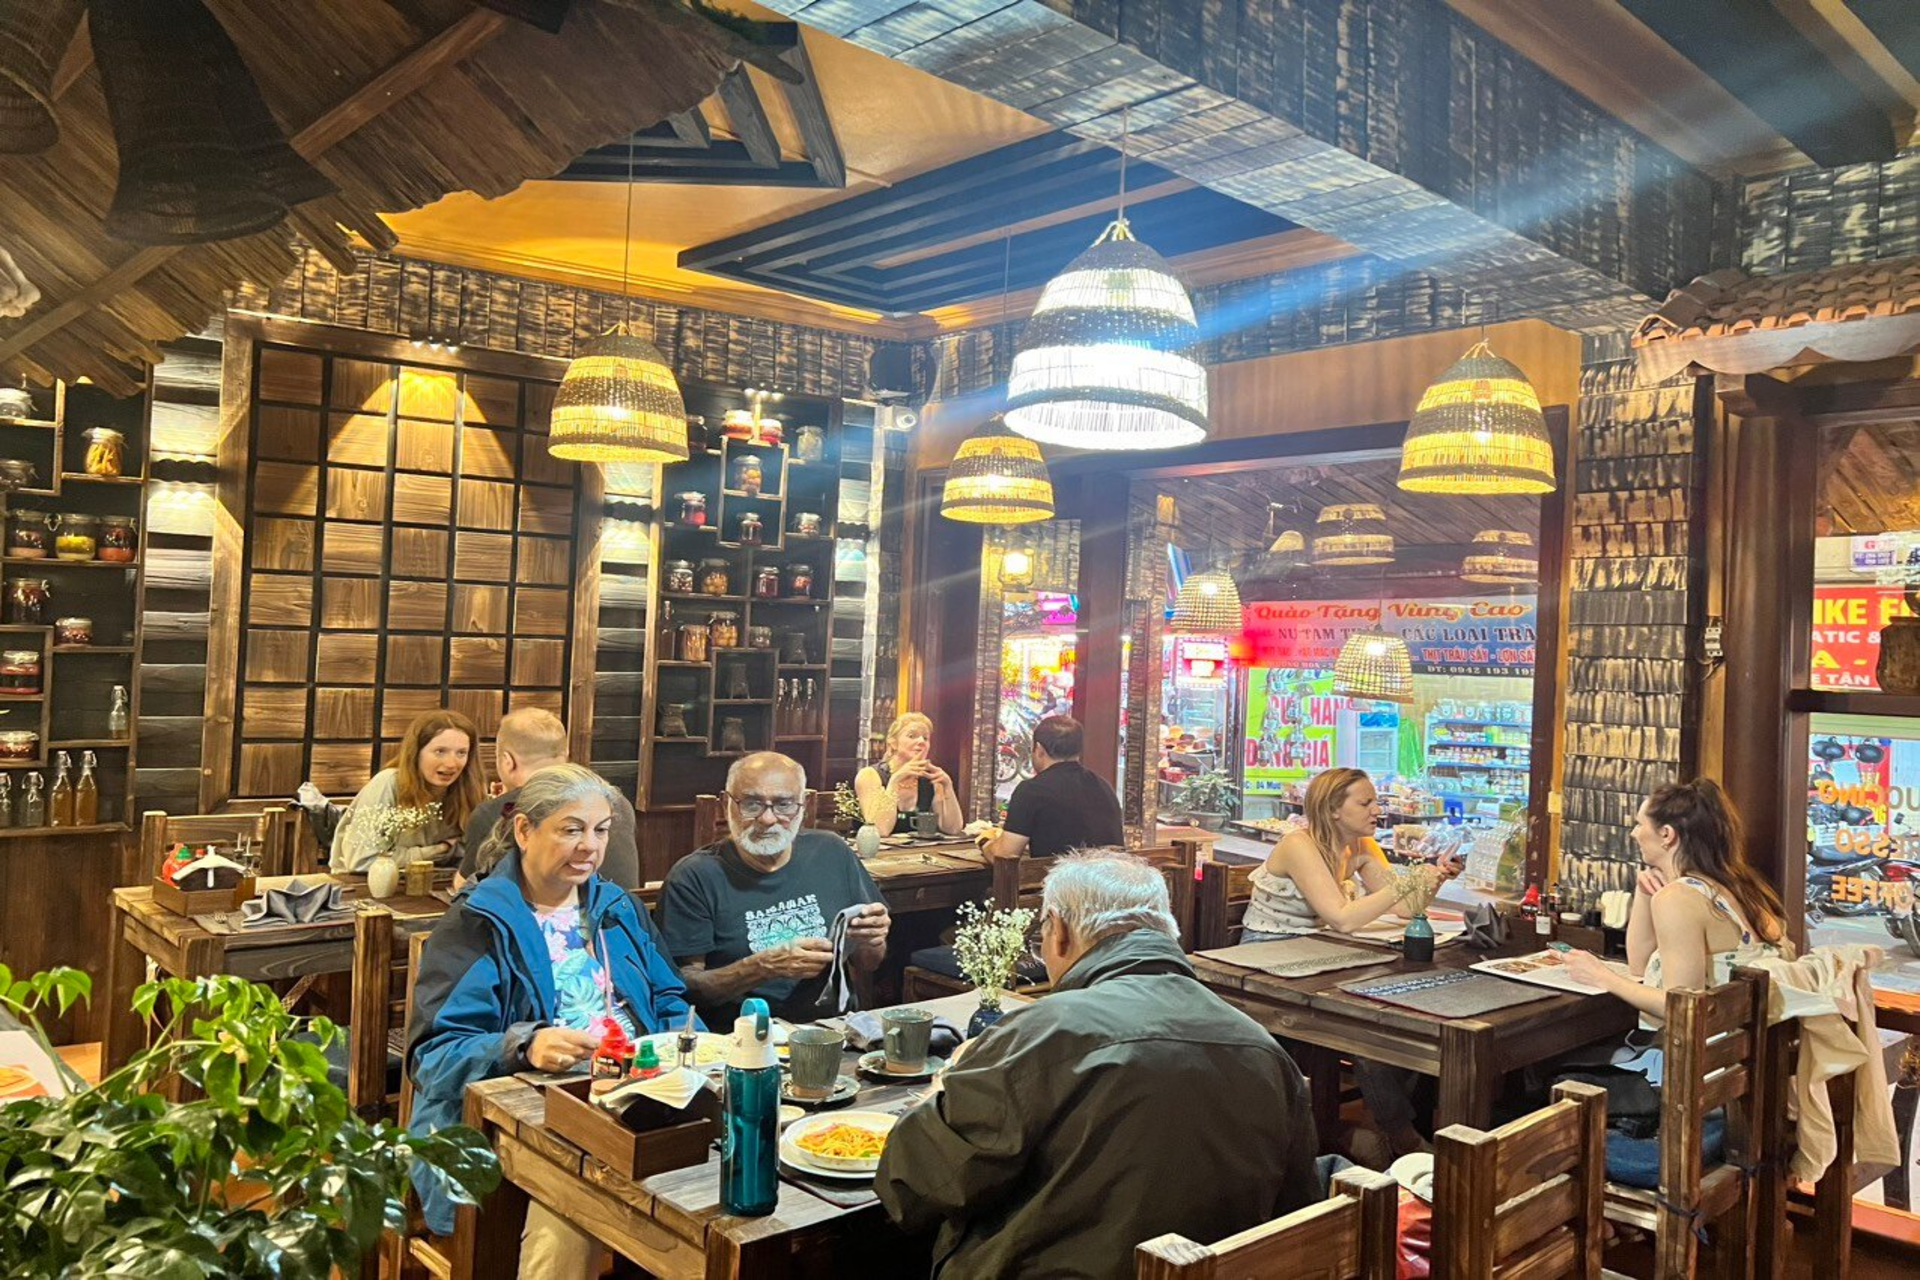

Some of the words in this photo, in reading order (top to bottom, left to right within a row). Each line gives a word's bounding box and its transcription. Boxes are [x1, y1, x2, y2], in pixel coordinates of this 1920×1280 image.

[1469, 601, 1531, 618] Cao
[1493, 623, 1535, 641] TRÀ
[1519, 644, 1535, 663] SẤ
